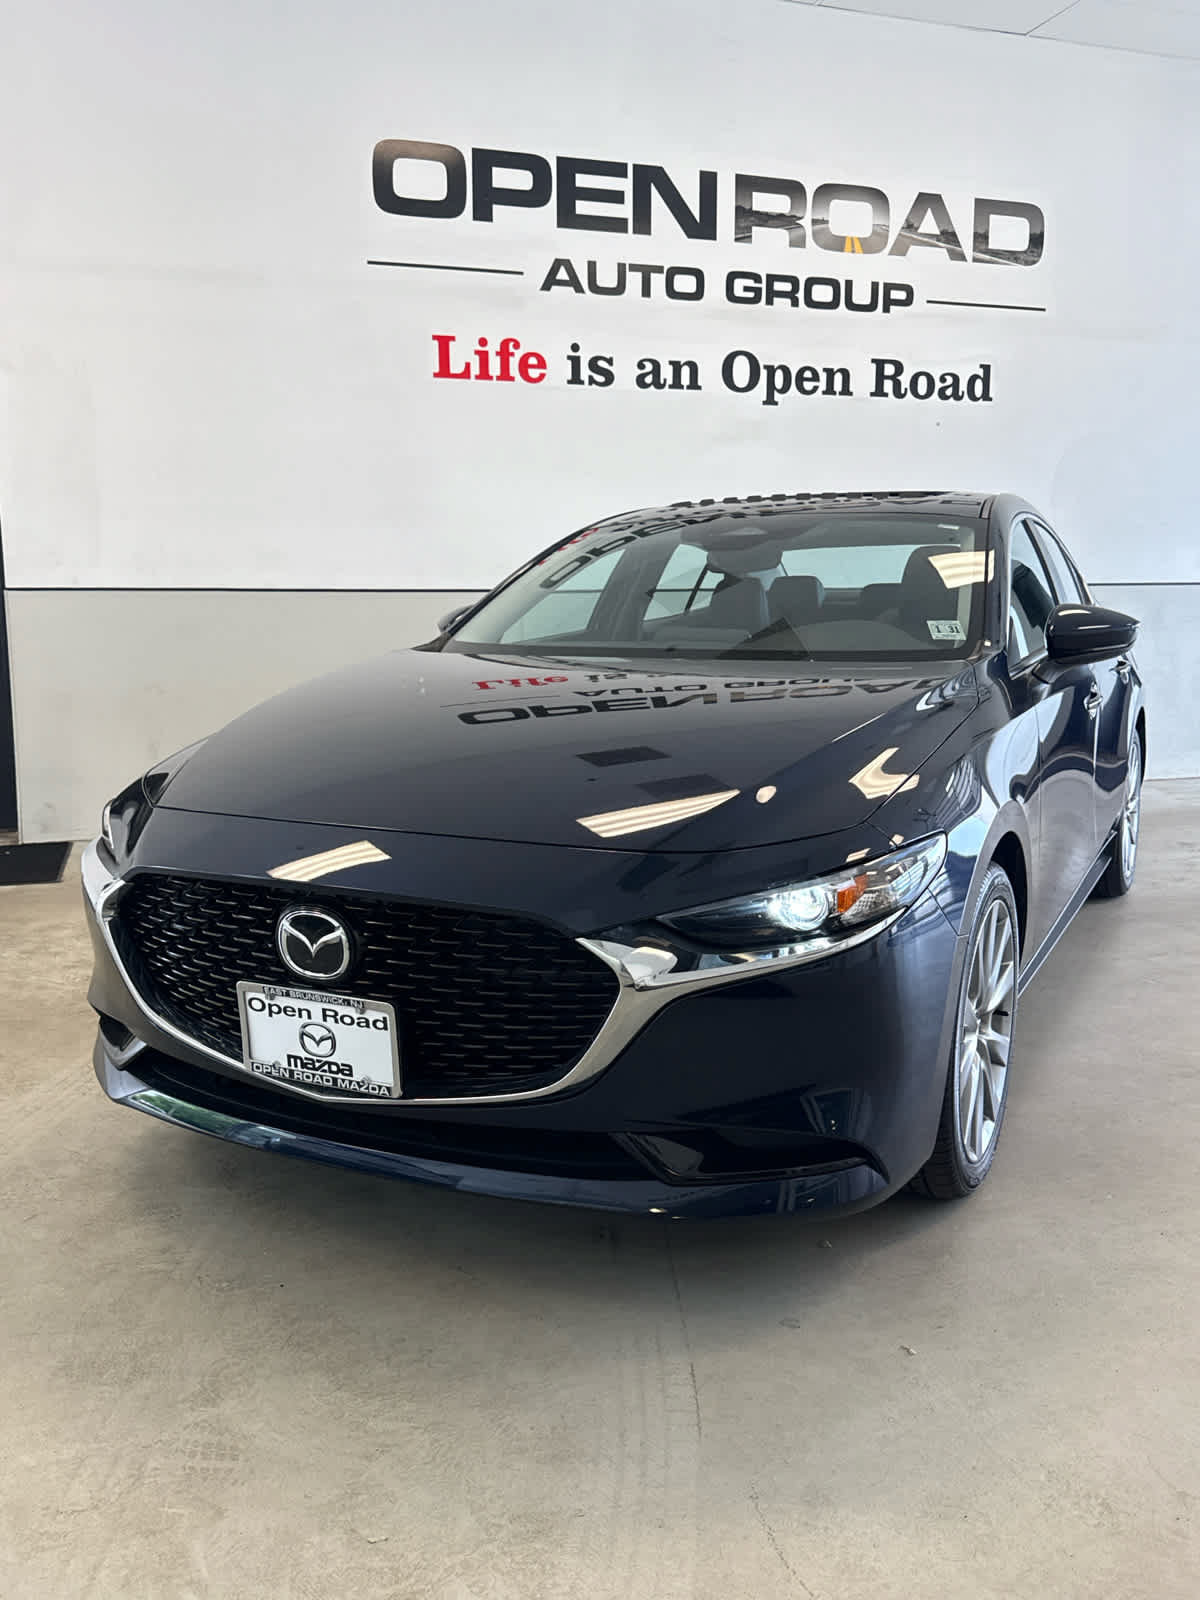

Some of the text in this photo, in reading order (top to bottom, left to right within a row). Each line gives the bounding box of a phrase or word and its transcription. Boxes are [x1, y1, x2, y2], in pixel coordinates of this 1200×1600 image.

[373, 140, 1045, 267] OPEN ROAD
[540, 258, 915, 313] AUTO GROUP
[431, 335, 993, 406] Life is an Open Road
[247, 997, 389, 1031] Open Road
[252, 1063, 390, 1097] OPEN ROAD MAZDA
[286, 1054, 354, 1077] mazda
